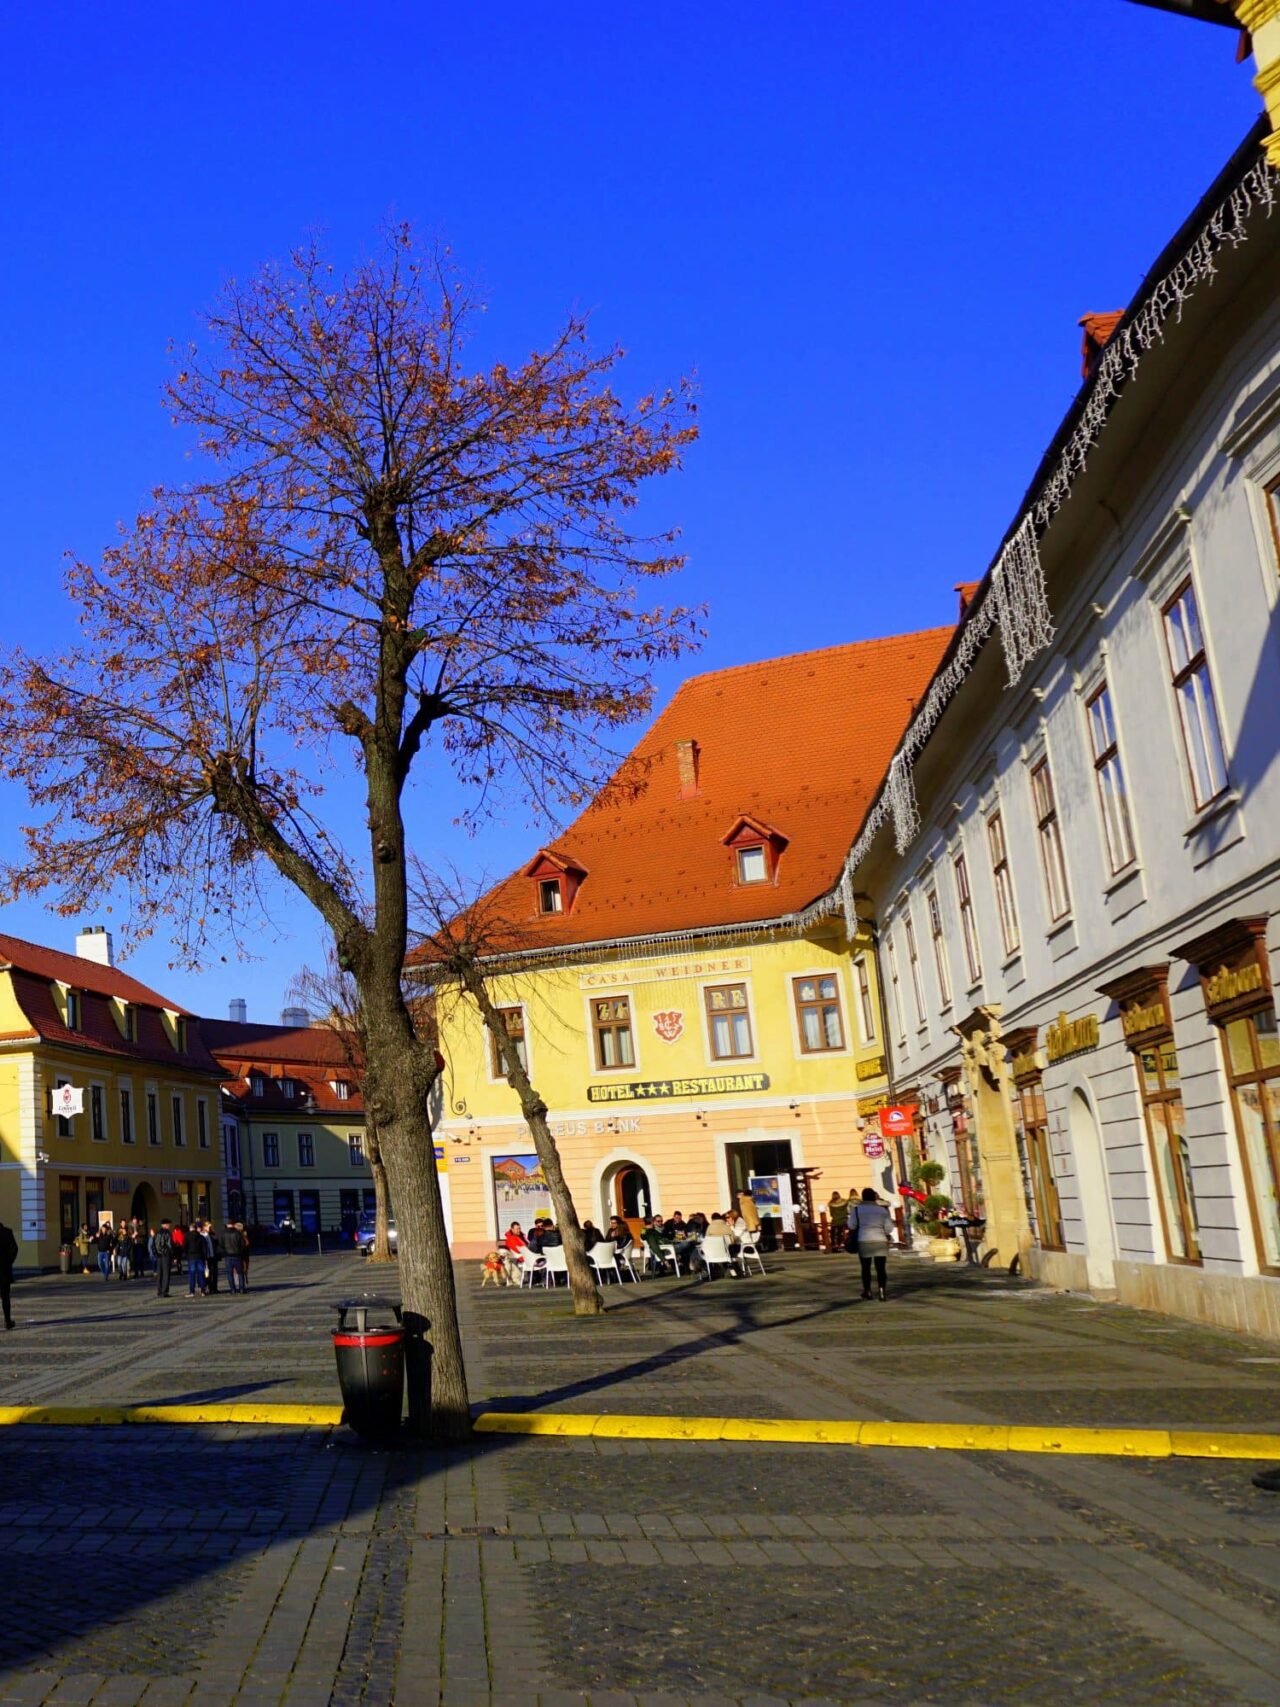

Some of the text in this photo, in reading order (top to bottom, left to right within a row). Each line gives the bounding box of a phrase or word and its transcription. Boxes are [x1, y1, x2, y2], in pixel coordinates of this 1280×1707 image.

[587, 961, 744, 986] CASA WEIDNER
[591, 1075, 764, 1100] HOTEL RESTAURANT
[595, 1118, 640, 1134] BANK
